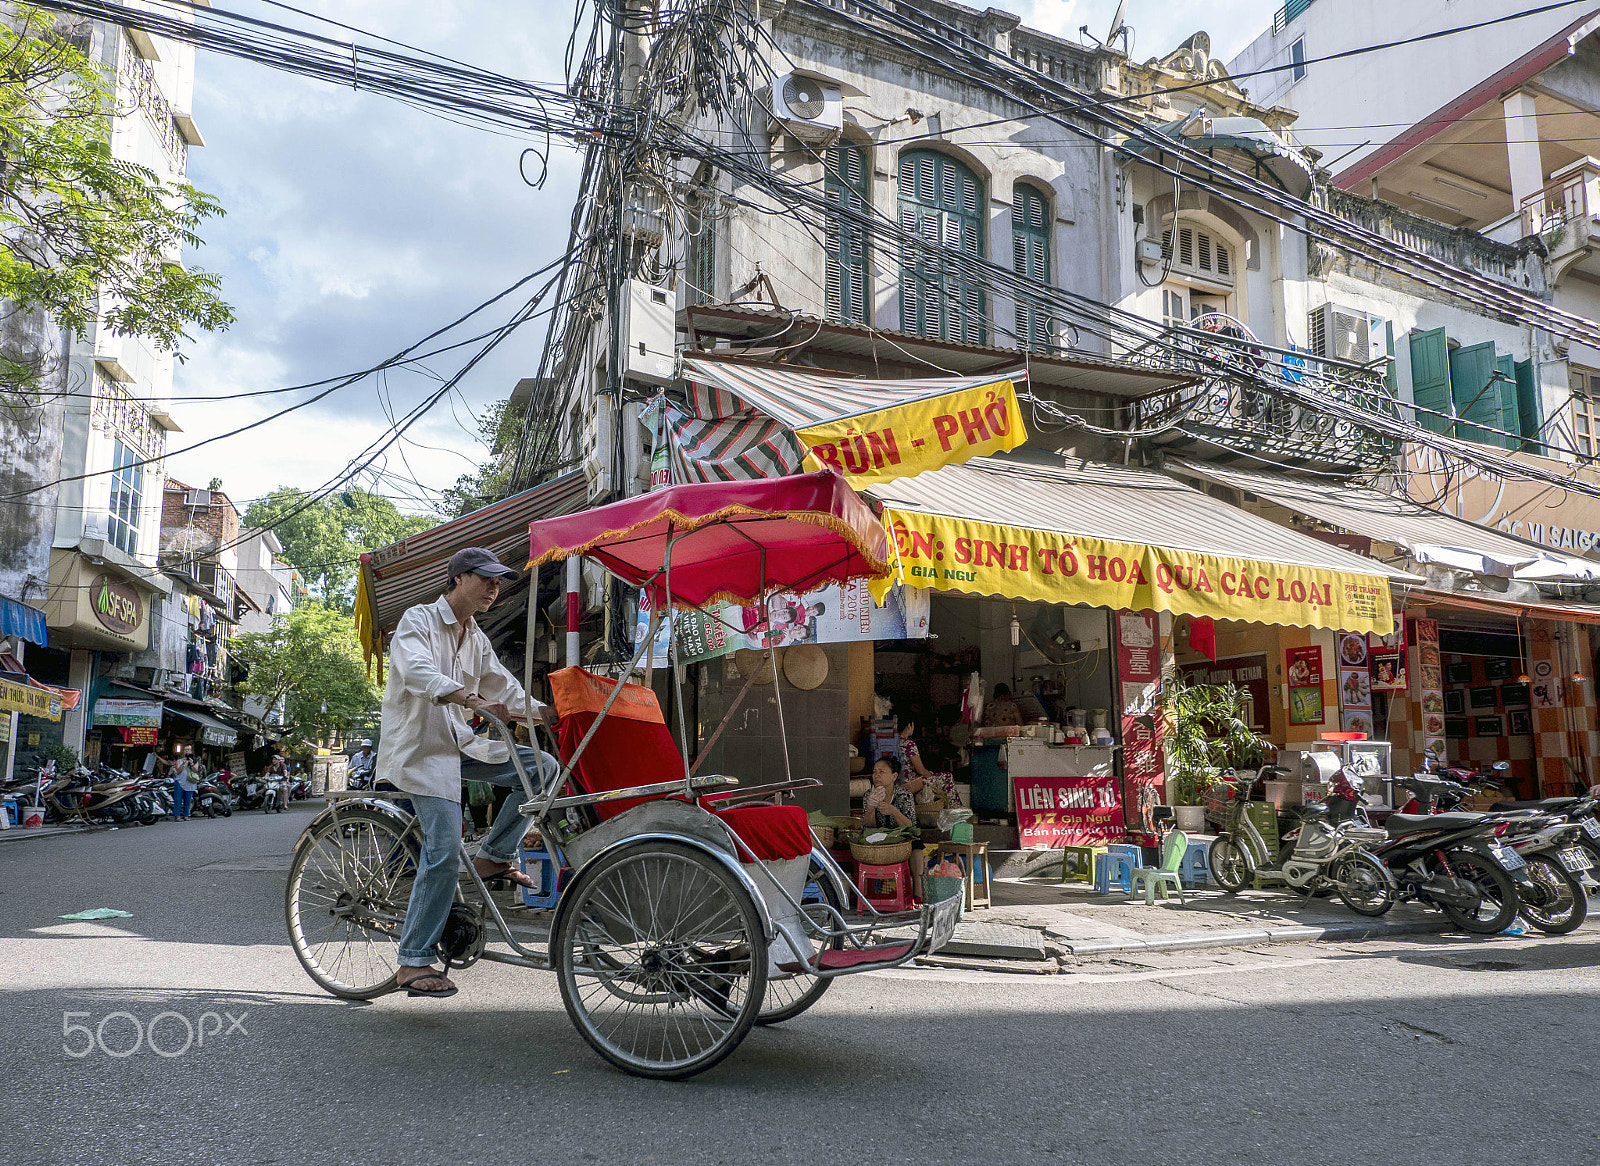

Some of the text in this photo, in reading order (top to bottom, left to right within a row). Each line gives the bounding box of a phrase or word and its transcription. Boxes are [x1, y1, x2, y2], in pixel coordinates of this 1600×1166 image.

[811, 427, 902, 477] BÚN
[932, 390, 1011, 453] PHỞ
[911, 565, 939, 578] GIA
[944, 569, 977, 582] NGƯ
[954, 537, 1030, 572] SINH
[1038, 540, 1079, 578] TỐ
[1086, 554, 1148, 585] HOA
[1155, 558, 1213, 594] QUẢ
[1220, 567, 1270, 600] CÁC
[1276, 578, 1333, 611] LOẠI
[108, 591, 121, 618] SF
[120, 597, 137, 626] SPA
[847, 594, 858, 620] 2016
[683, 615, 691, 634] VIỆT
[690, 617, 699, 636] ĐÀO
[686, 636, 697, 656] NAM
[694, 636, 704, 654] TẠO
[1235, 665, 1262, 682] VIETNAM
[1019, 780, 1116, 810] LIÊN SINH TỐ
[1032, 812, 1058, 824] 17
[1086, 814, 1112, 824] Ngư
[1023, 827, 1049, 837] Bán
